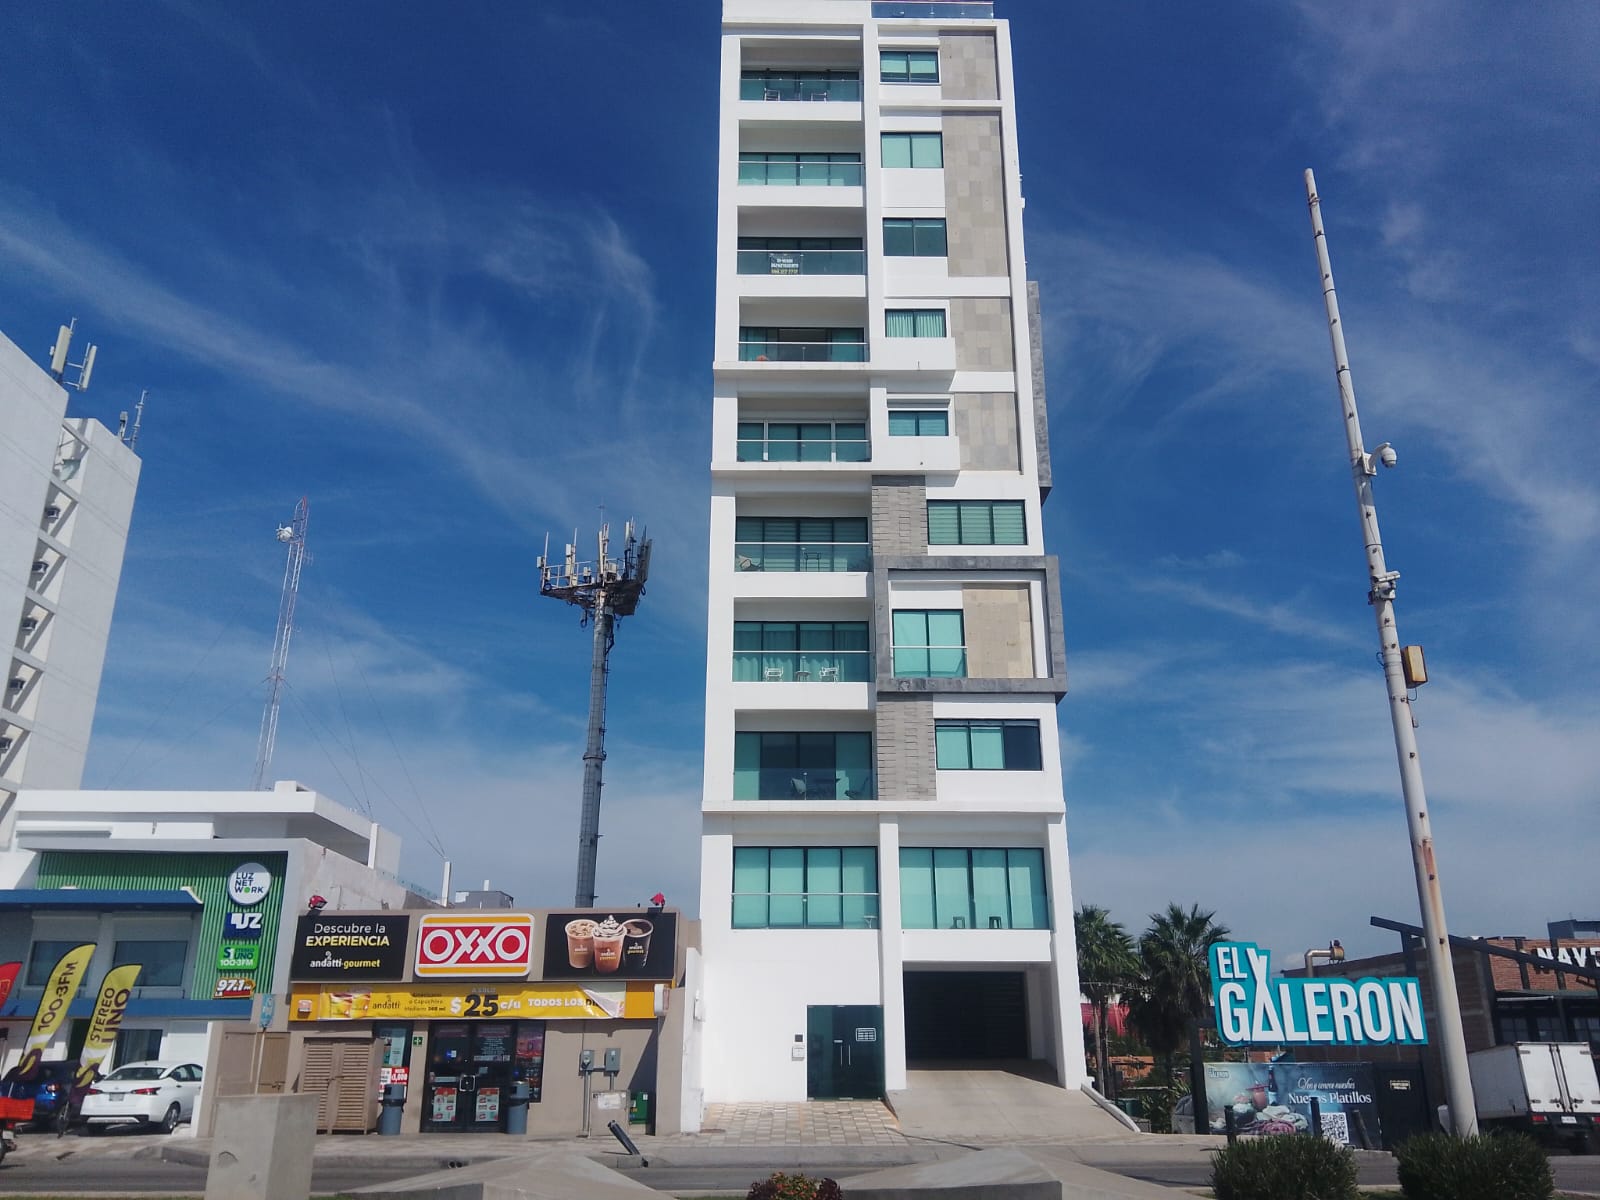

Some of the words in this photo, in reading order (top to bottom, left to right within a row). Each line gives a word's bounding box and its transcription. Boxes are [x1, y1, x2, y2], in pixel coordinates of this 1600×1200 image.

[236, 872, 254, 880] LUZ
[314, 923, 372, 933] Descubre
[375, 923, 386, 933] la
[305, 935, 390, 946] EXPERIENCIA
[423, 927, 527, 962] OXXO
[1216, 947, 1247, 978] EL
[529, 998, 562, 1007] TODOS
[564, 998, 583, 1007] LOS
[1219, 947, 1425, 1042] GALERON
[90, 987, 115, 1042] STEREO
[102, 989, 130, 1043] UNO
[1329, 1091, 1372, 1104] Platillos
